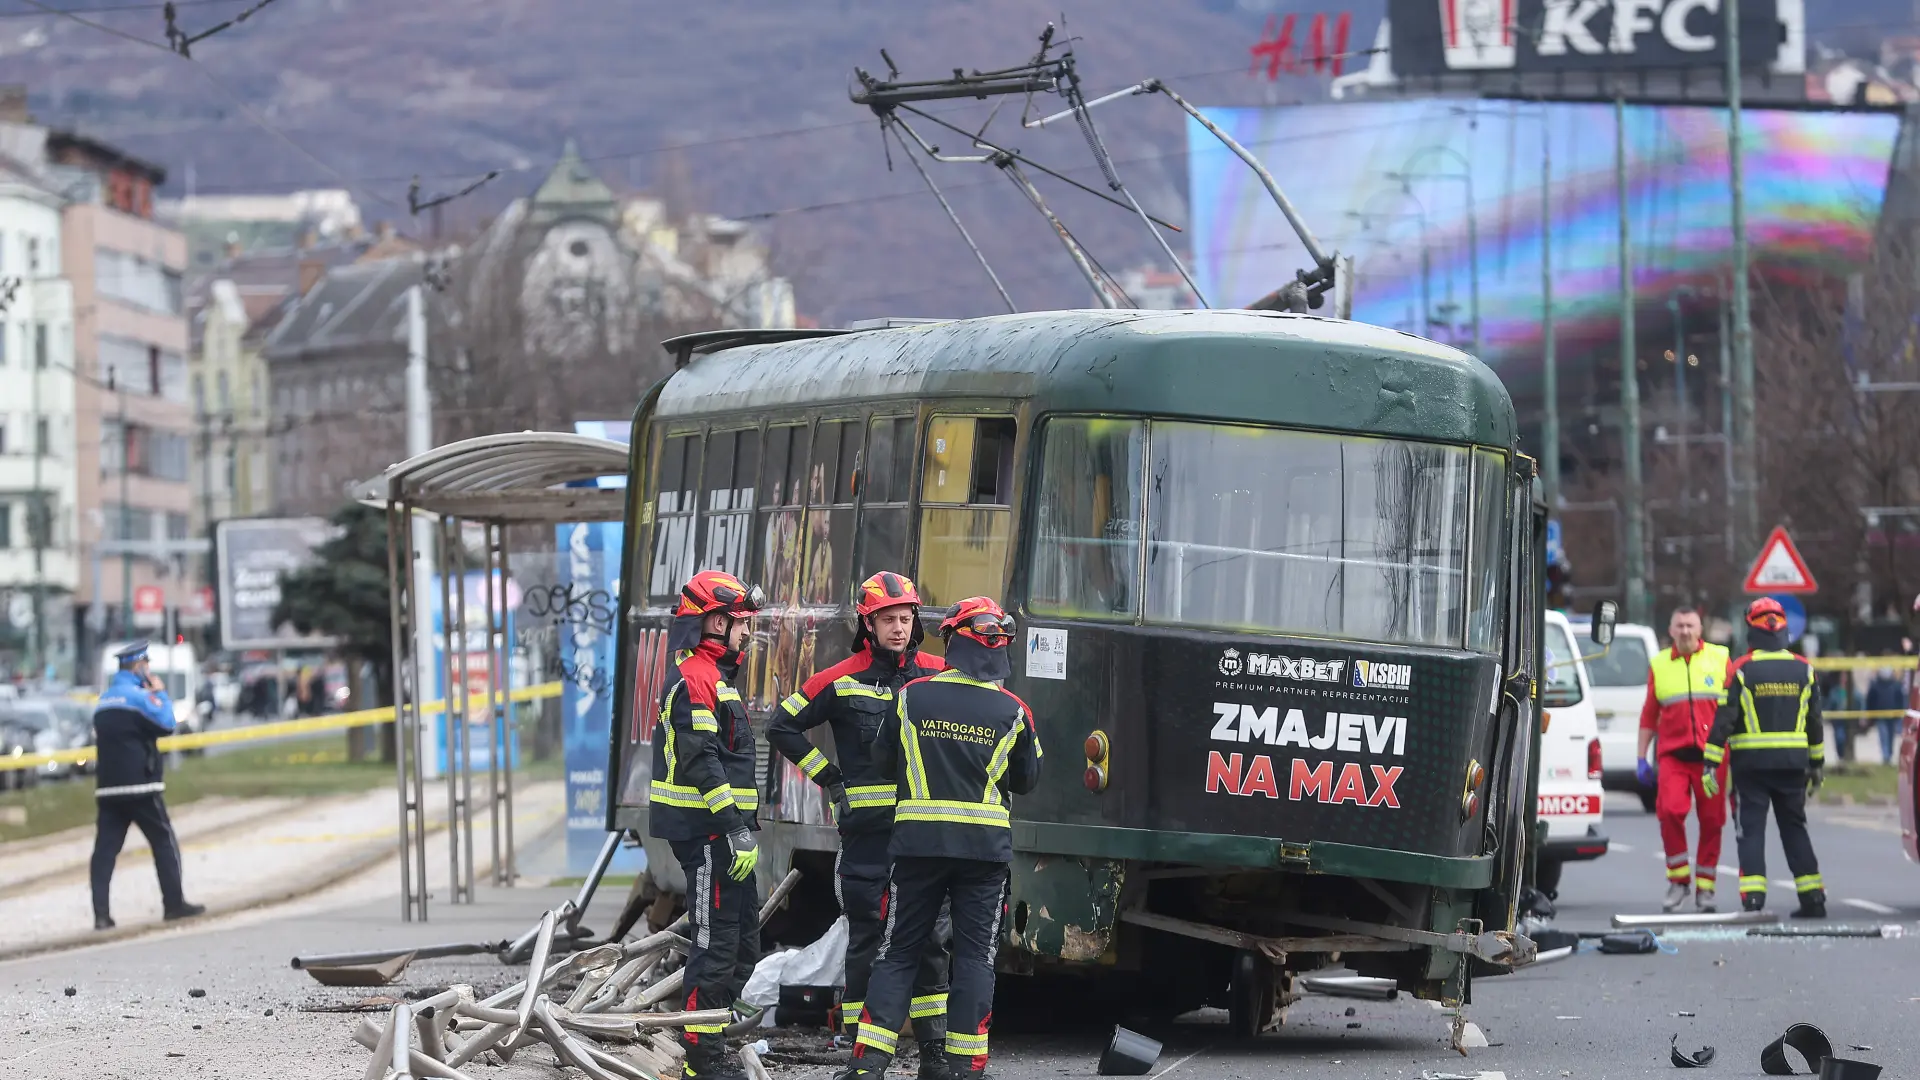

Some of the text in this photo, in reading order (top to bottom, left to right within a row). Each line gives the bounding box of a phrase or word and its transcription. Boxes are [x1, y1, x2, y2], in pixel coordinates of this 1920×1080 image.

[1537, 0, 1718, 55] KFC
[1368, 662, 1412, 686] KSBIH
[1215, 681, 1410, 704] PREMIUM PARTNER REPREZENTACIJE
[920, 730, 994, 747] KANTON SARAJEVO
[921, 719, 996, 739] VATROGASCI
[1210, 702, 1408, 756] ZMAJEVI
[1206, 750, 1404, 809] NA MAX
